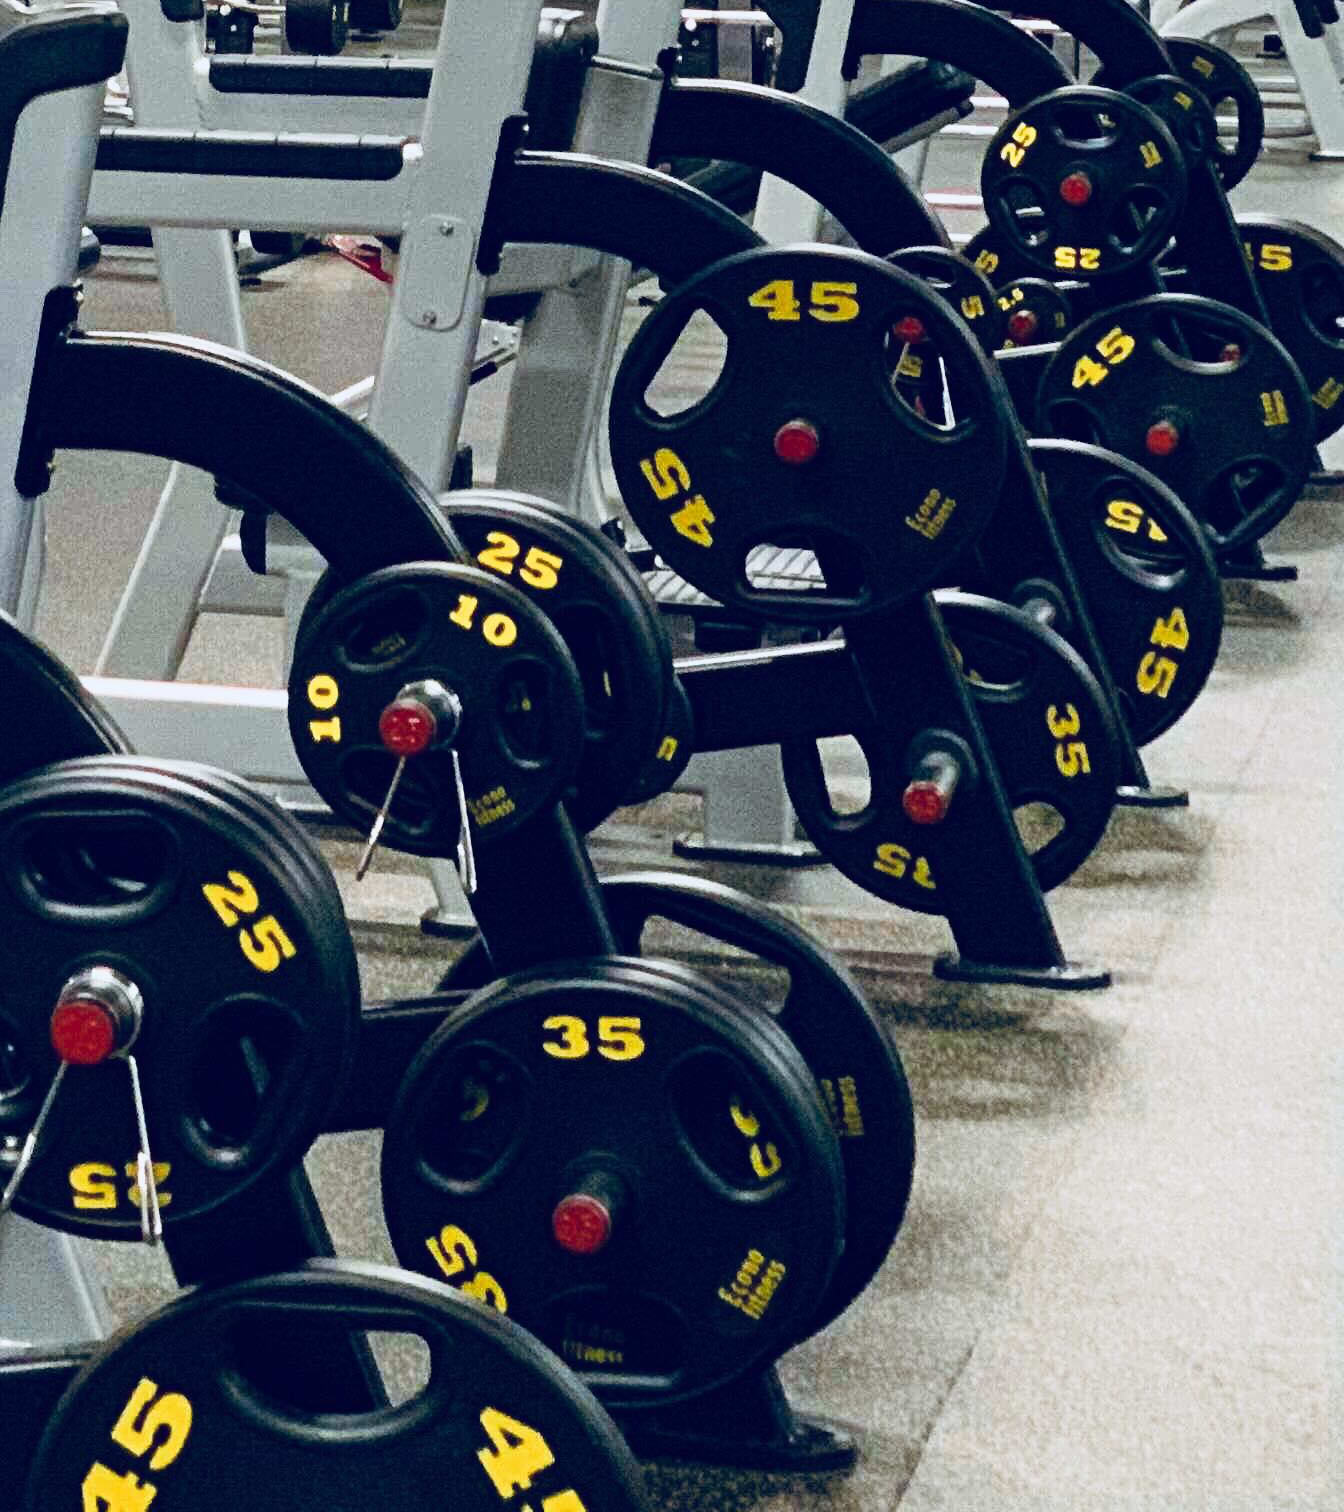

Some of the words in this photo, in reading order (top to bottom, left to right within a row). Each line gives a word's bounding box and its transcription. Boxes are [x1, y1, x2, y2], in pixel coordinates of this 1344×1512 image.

[1000, 121, 1038, 168] 25
[1054, 245, 1101, 270] 25
[747, 279, 860, 323] 45
[1072, 326, 1136, 389] 45
[639, 447, 716, 548] 45
[476, 530, 563, 590] 25
[448, 593, 518, 647] 10
[1136, 606, 1190, 699] 45
[306, 673, 342, 744] 10
[1045, 702, 1092, 778] 35
[202, 870, 297, 973] 25
[541, 1014, 647, 1062] 35
[475, 1405, 588, 1512] 4
